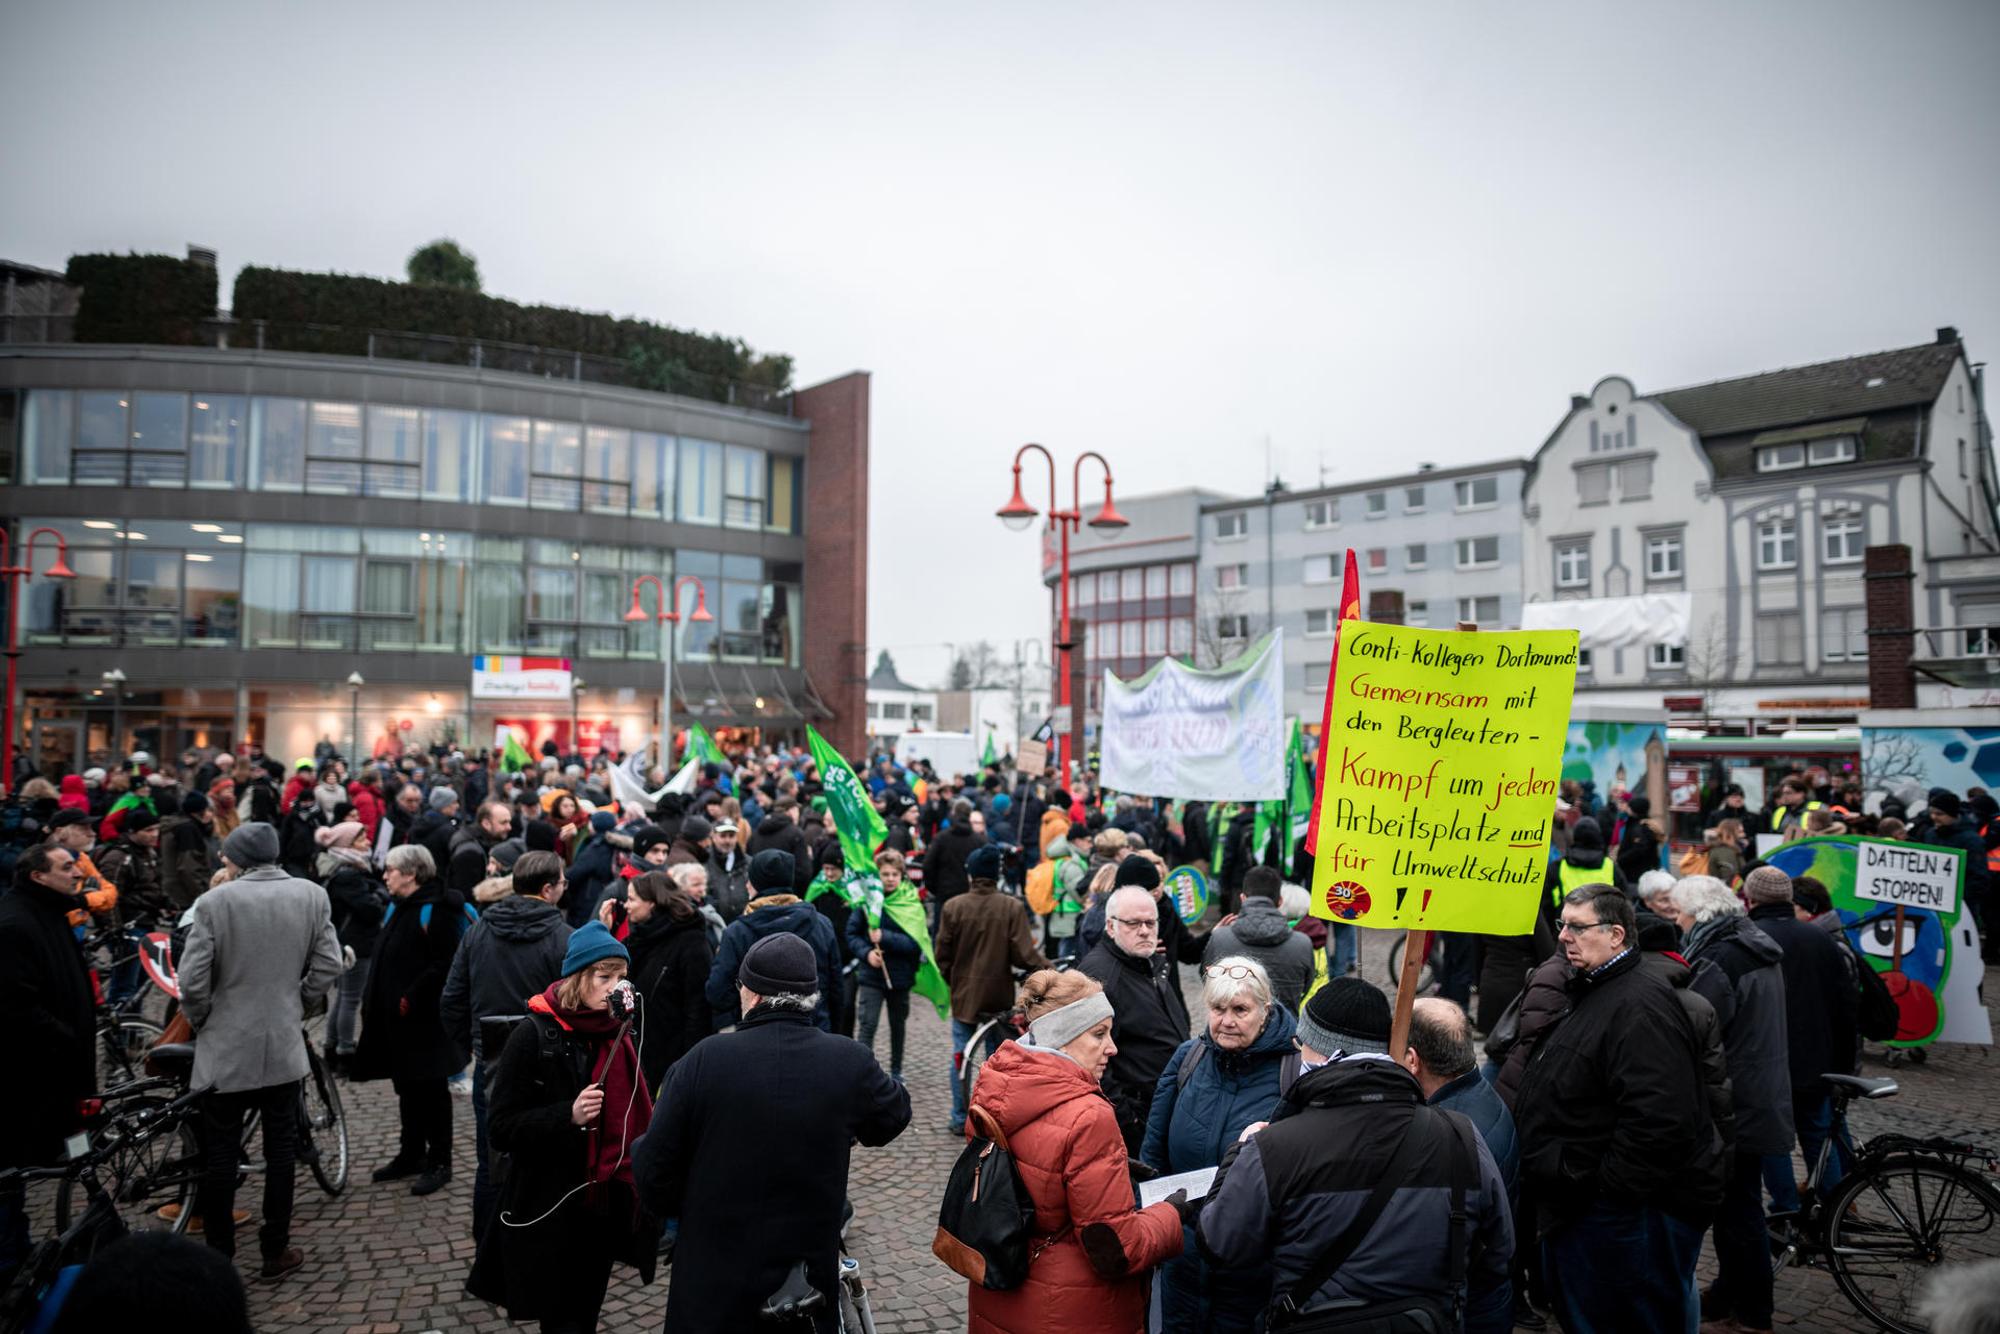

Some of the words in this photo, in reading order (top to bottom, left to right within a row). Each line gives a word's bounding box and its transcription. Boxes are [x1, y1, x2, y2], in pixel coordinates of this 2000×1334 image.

[1350, 632, 1484, 675] Conti-Kollegen
[1496, 643, 1578, 668] Dortmund:
[1350, 673, 1488, 708] Gemeinsam
[1504, 686, 1538, 710] mit
[1346, 710, 1382, 731] den
[1397, 715, 1519, 748] Bergleuten
[1340, 746, 1444, 803] Kampf
[1449, 777, 1483, 796] um
[1485, 767, 1556, 811] jeden
[1336, 798, 1501, 851] Arbeitsplatz
[1510, 818, 1546, 843] und
[1330, 842, 1376, 873] für
[1392, 849, 1541, 885] Umweltschutz
[1867, 846, 1938, 875] DATTELN
[1943, 857, 1952, 876] 4
[1334, 885, 1352, 899] 30
[1870, 877, 1944, 906] STOPPEN!
